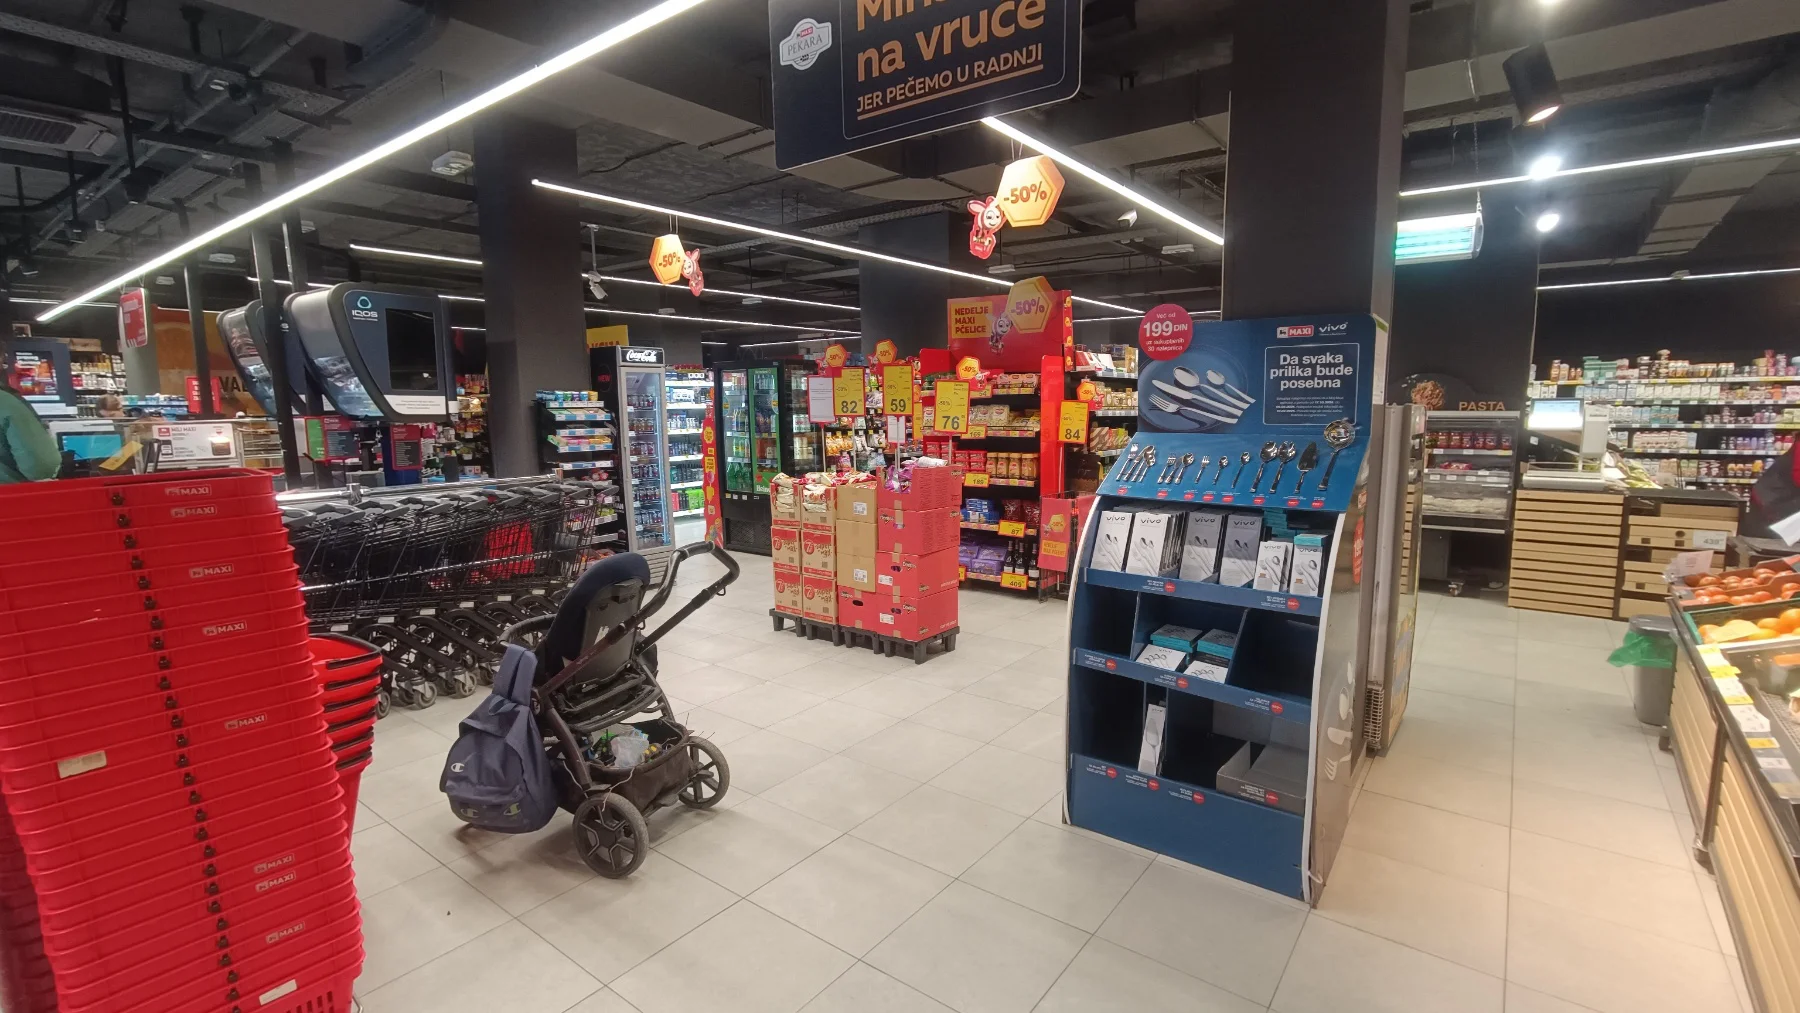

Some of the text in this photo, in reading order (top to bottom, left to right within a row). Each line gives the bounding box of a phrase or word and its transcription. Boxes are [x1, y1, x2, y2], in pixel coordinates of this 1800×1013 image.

[787, 34, 822, 56] PEKARA
[857, 39, 905, 82] na
[856, 42, 1043, 113] JER PEČEMO U RADNJI
[1003, 181, 1048, 204] -50%
[954, 306, 989, 316] NEDELJE
[1010, 296, 1045, 316] -50%
[351, 309, 379, 318] IQOS
[954, 316, 975, 325] MAXI
[955, 325, 987, 334] PČELICE
[1143, 320, 1188, 337] 199 DIN
[1289, 327, 1312, 336] MAXI
[1318, 322, 1347, 333] vivo
[1279, 352, 1344, 365] Da svaka
[1270, 364, 1353, 380] prilika bude
[1280, 377, 1341, 391] posebna
[840, 400, 858, 413] 82
[890, 398, 907, 412] 59
[1458, 401, 1506, 411] PASTA
[941, 415, 960, 430] 76
[1064, 428, 1081, 440] 84
[180, 486, 209, 495] MAXI
[186, 506, 215, 515] MAXI
[1106, 515, 1126, 523] vivo
[1140, 516, 1161, 524] vivo
[1194, 516, 1216, 524] vivo
[1233, 519, 1256, 528] vivo
[203, 565, 232, 575] MAXI
[217, 622, 245, 633] MAXI
[238, 714, 265, 727] MAXI
[267, 855, 293, 870] MAXI
[269, 873, 294, 888] MAXI
[278, 923, 304, 940] MAXI
